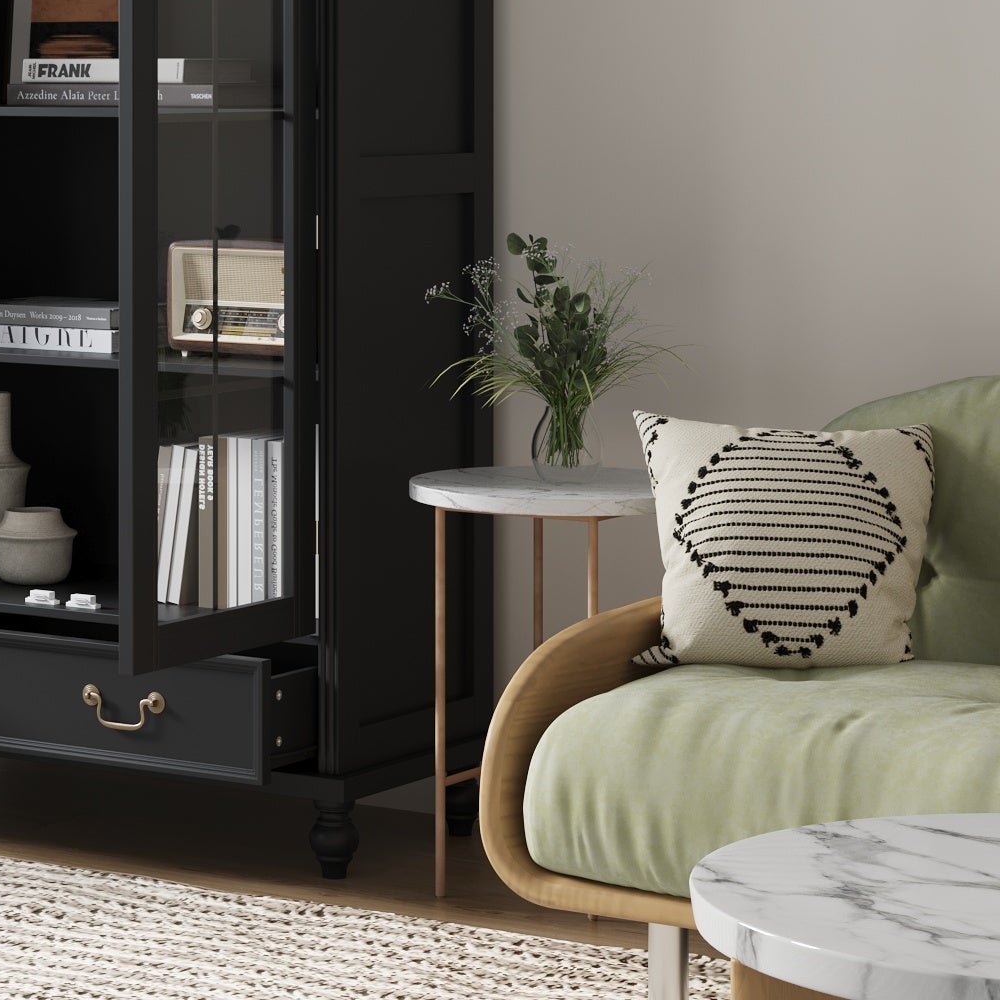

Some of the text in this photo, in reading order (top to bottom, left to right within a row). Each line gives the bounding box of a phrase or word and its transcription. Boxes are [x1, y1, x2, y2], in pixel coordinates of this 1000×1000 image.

[37, 63, 91, 78] FRANK
[16, 89, 58, 100] Azzedine
[88, 90, 111, 100] Peter
[4, 309, 26, 320] Duysen
[29, 311, 48, 320] Works
